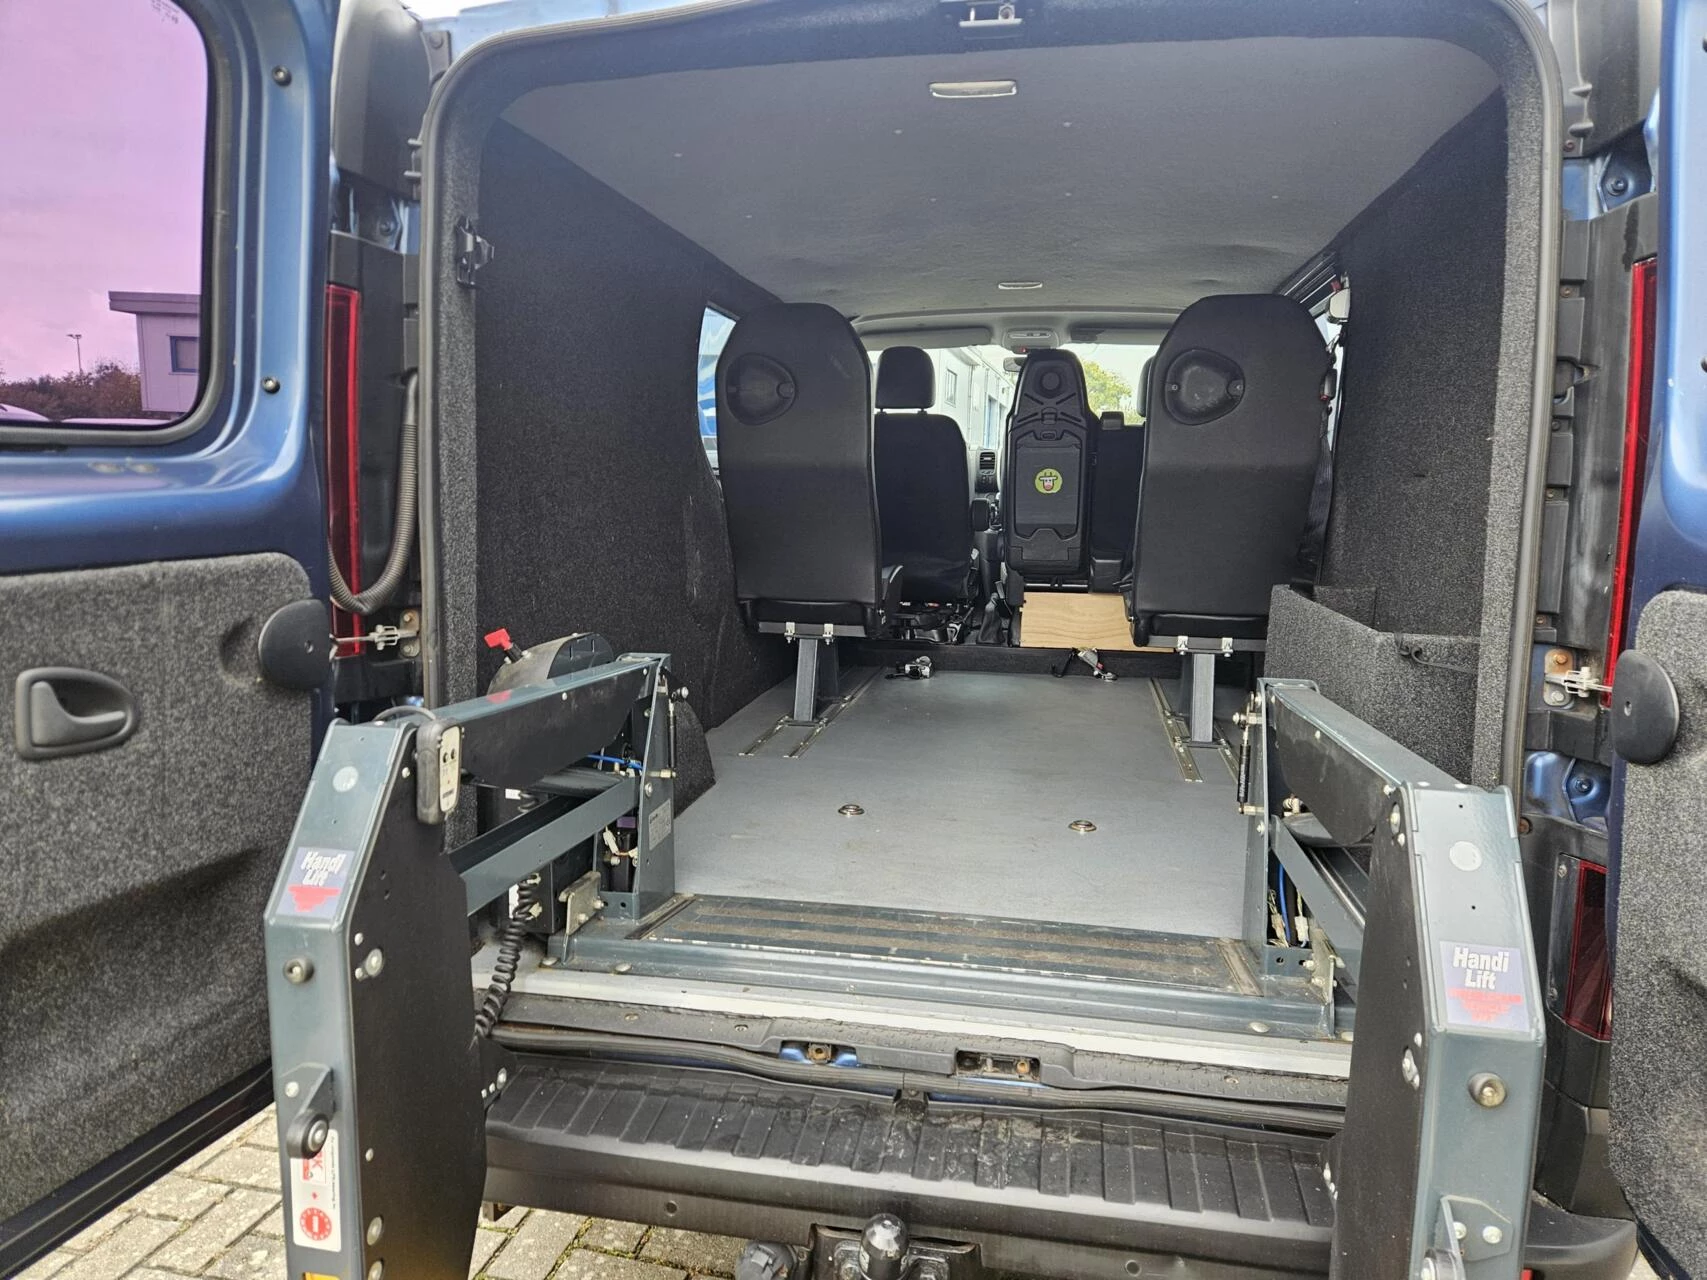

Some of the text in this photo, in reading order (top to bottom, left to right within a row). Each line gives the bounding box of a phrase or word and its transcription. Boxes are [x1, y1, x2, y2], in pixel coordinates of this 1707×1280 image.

[301, 851, 347, 873] Handi
[302, 869, 329, 887] Lift
[1452, 946, 1510, 973] Handi
[1464, 969, 1496, 990] Lift
